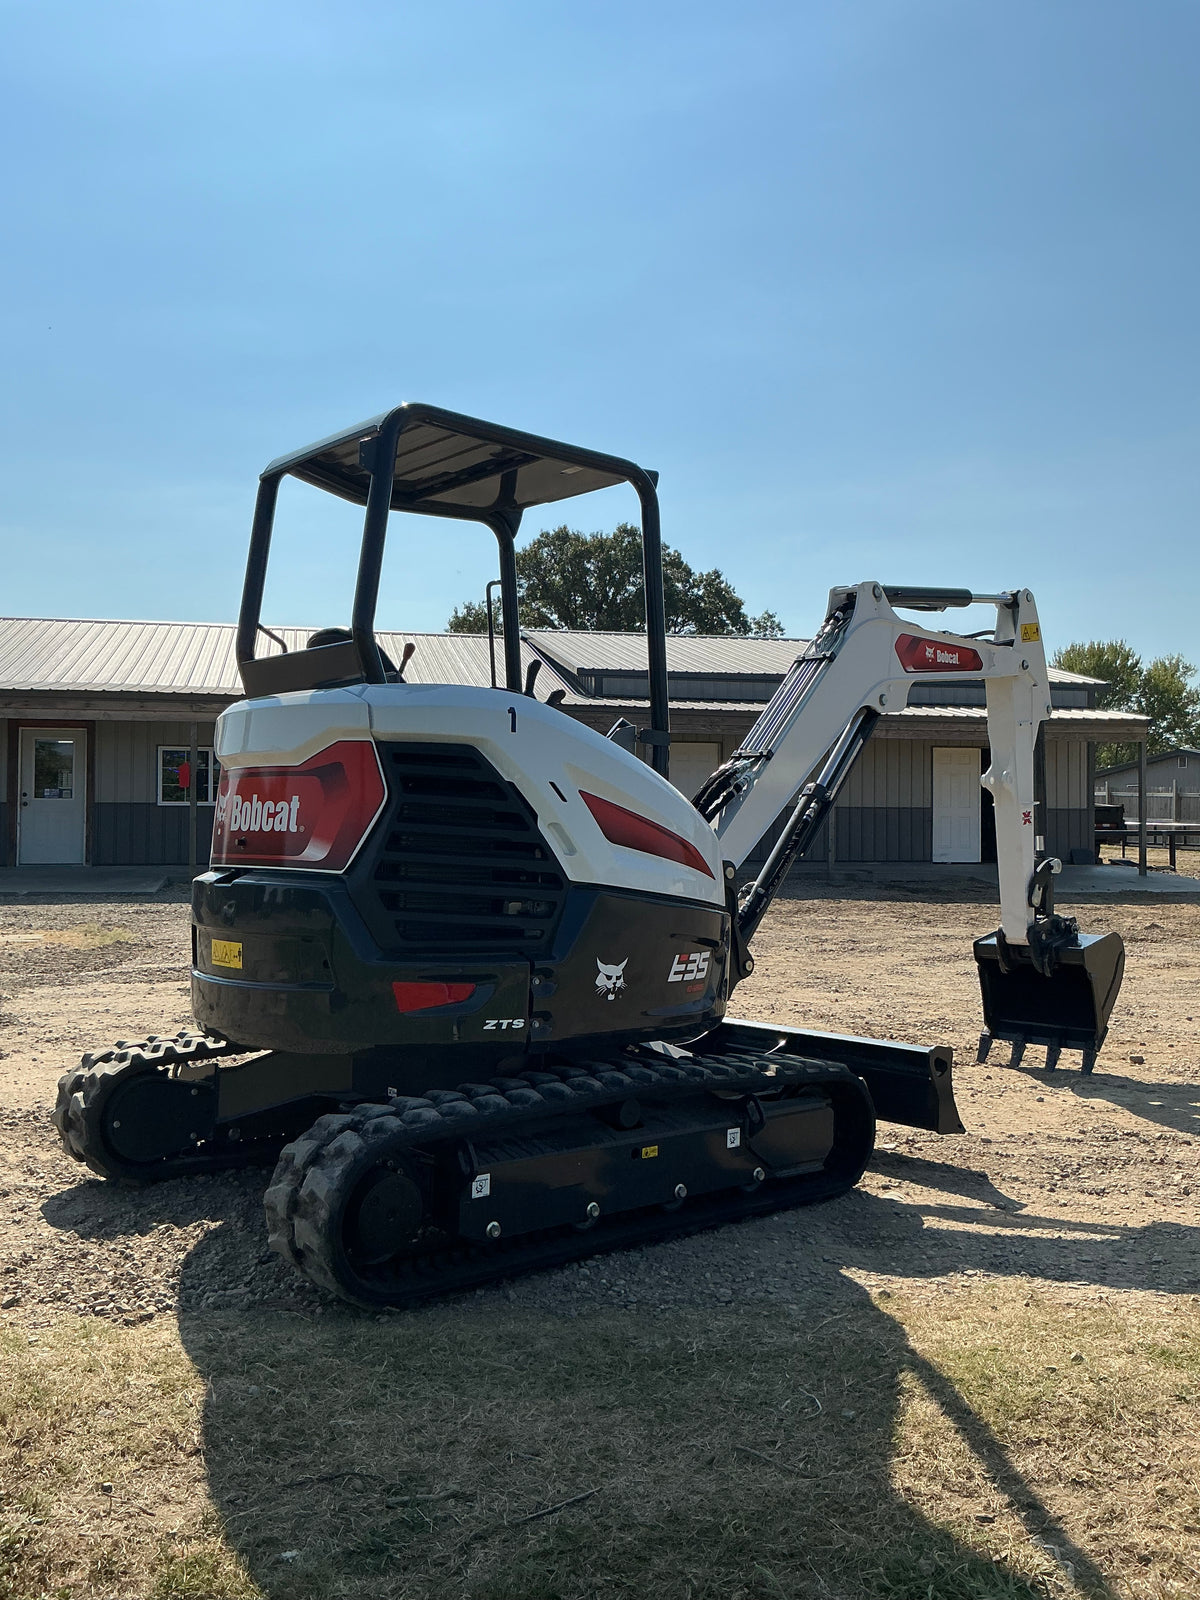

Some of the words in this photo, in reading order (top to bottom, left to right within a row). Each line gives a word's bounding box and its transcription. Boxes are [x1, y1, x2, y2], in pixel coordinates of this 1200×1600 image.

[936, 650, 959, 664] Bobcat
[230, 794, 300, 833] Bobcat
[668, 951, 711, 982] E35
[483, 1018, 526, 1030] ZTS
